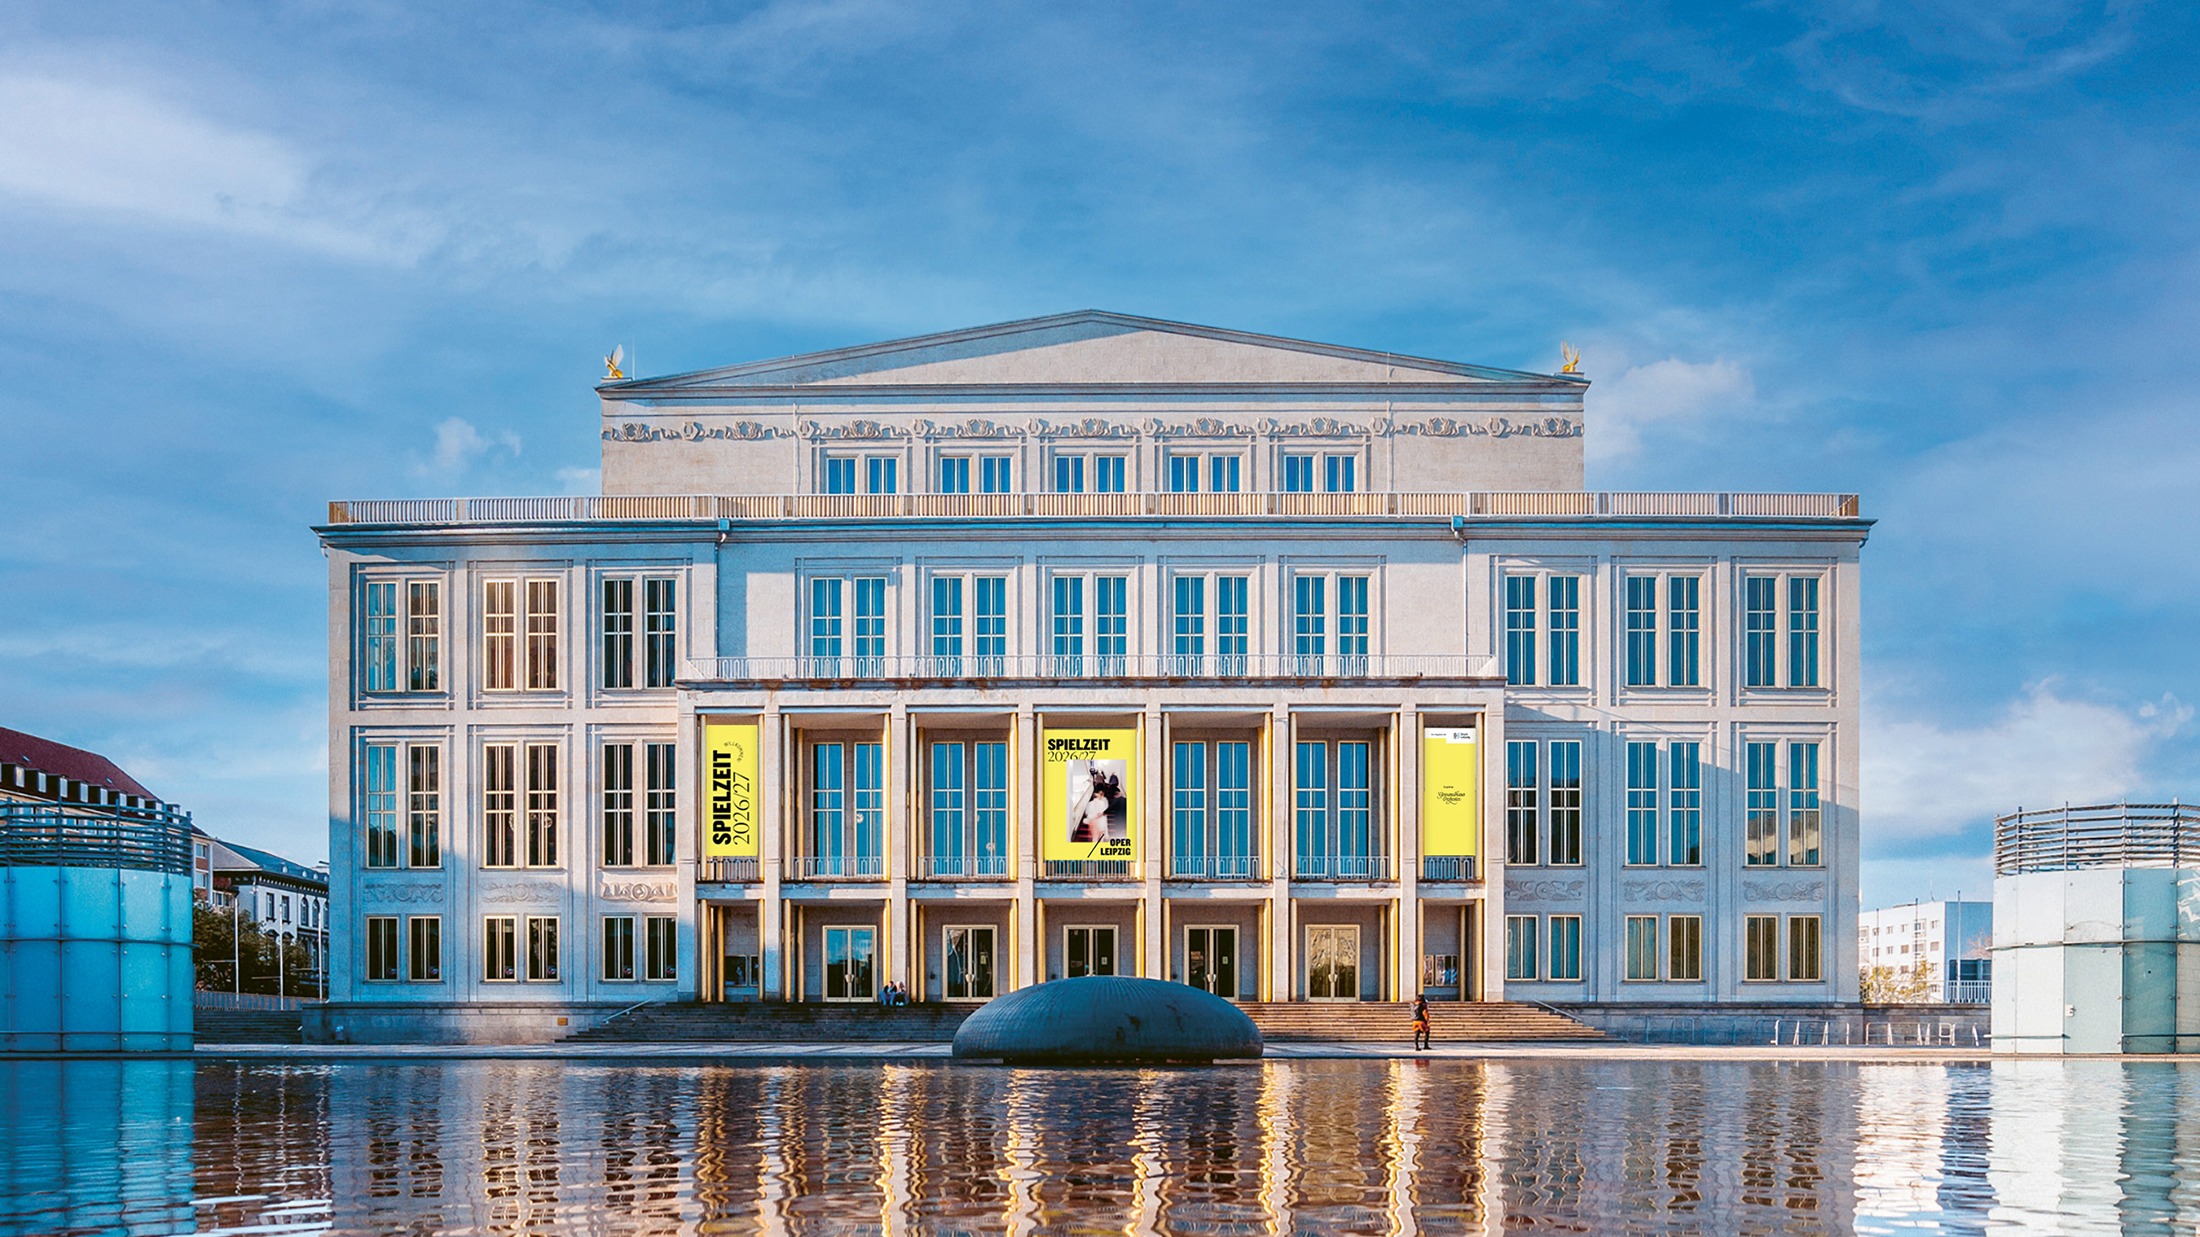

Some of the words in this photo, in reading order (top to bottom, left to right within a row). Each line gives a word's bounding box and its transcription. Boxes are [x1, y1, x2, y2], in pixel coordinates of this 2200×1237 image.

[1048, 739, 1110, 750] SPIELZEIT
[1047, 751, 1097, 762] 2026/27
[713, 750, 731, 845] SPIELZEIT
[733, 772, 750, 845] 2026/27
[1110, 838, 1131, 847] OPER
[1100, 847, 1131, 856] LEIPZIG
